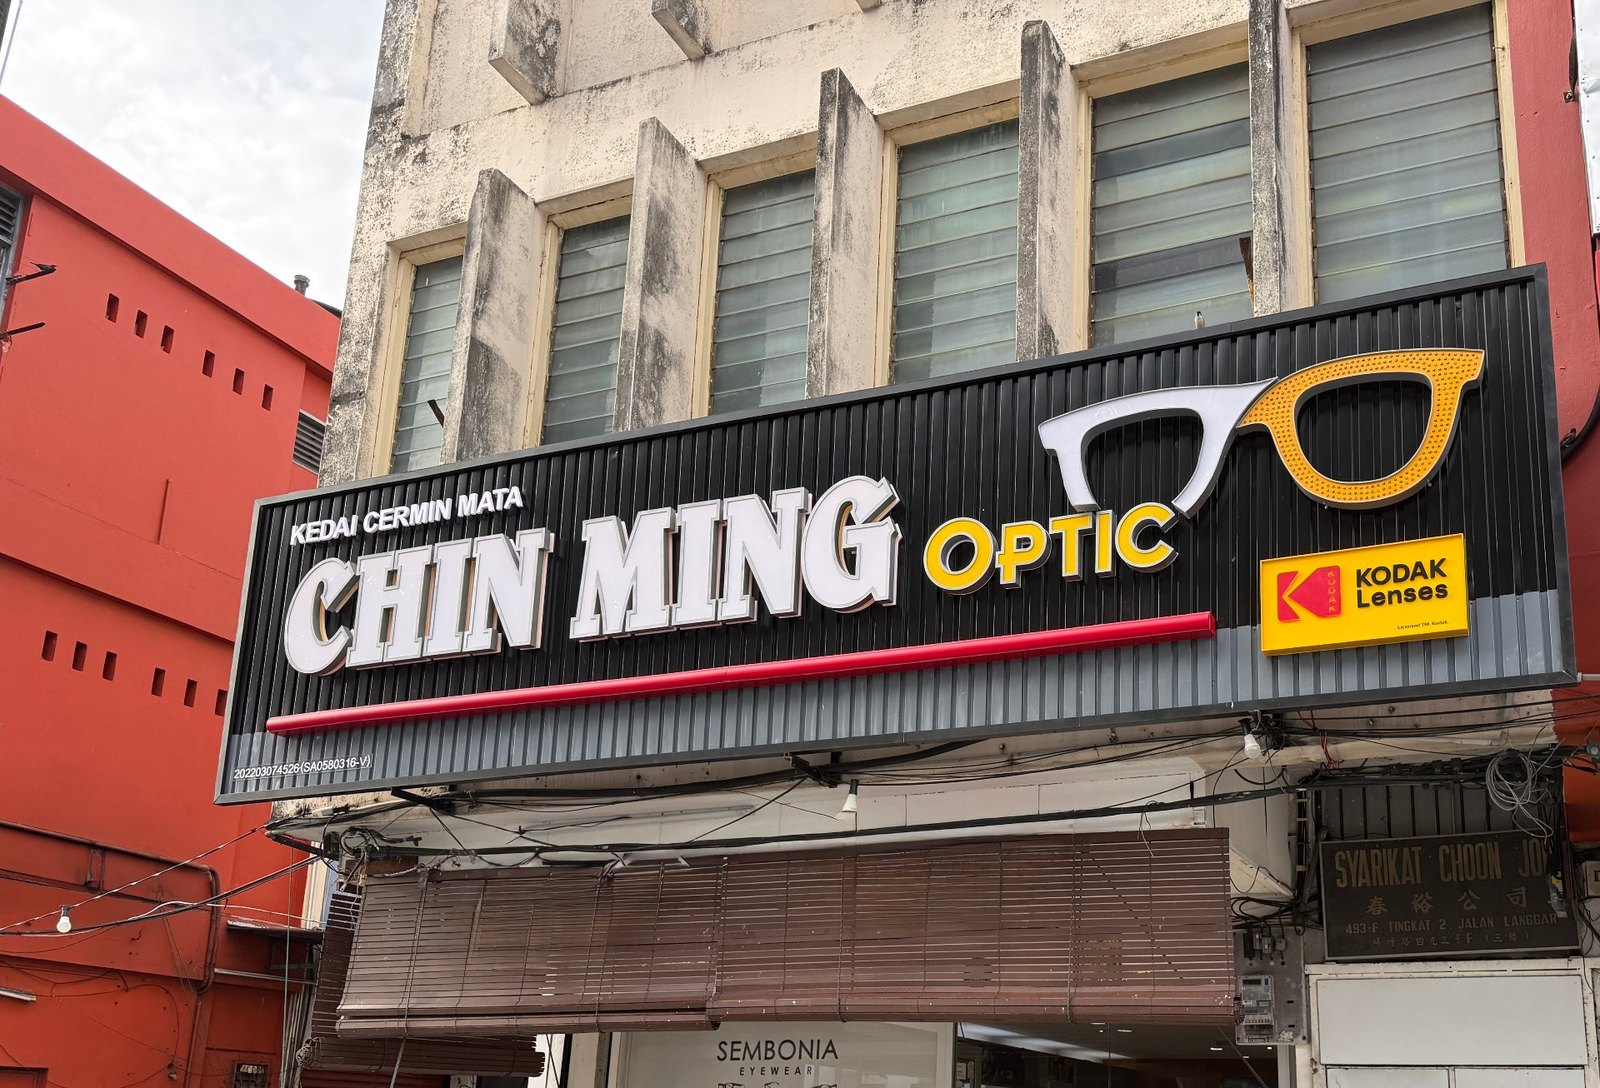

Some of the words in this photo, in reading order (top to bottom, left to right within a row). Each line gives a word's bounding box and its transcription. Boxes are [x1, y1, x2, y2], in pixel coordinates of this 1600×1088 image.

[289, 515, 358, 546] KEDAI
[363, 499, 453, 533] CERMIN
[457, 486, 524, 517] MATA
[284, 526, 555, 676] CHIN
[569, 474, 903, 642] MING
[923, 501, 1180, 596] OPTIC
[1356, 558, 1447, 588] KODAK
[1357, 584, 1448, 608] Lenses
[1334, 846, 1422, 889] SYARIKAT
[1438, 841, 1502, 883] CHOON
[1388, 920, 1431, 931] TINGKAT
[1458, 916, 1495, 929] JALAN
[1504, 912, 1558, 927] LANGGAR
[717, 1039, 839, 1061] SEMBONIA
[739, 1066, 813, 1075] EYEWEAR
